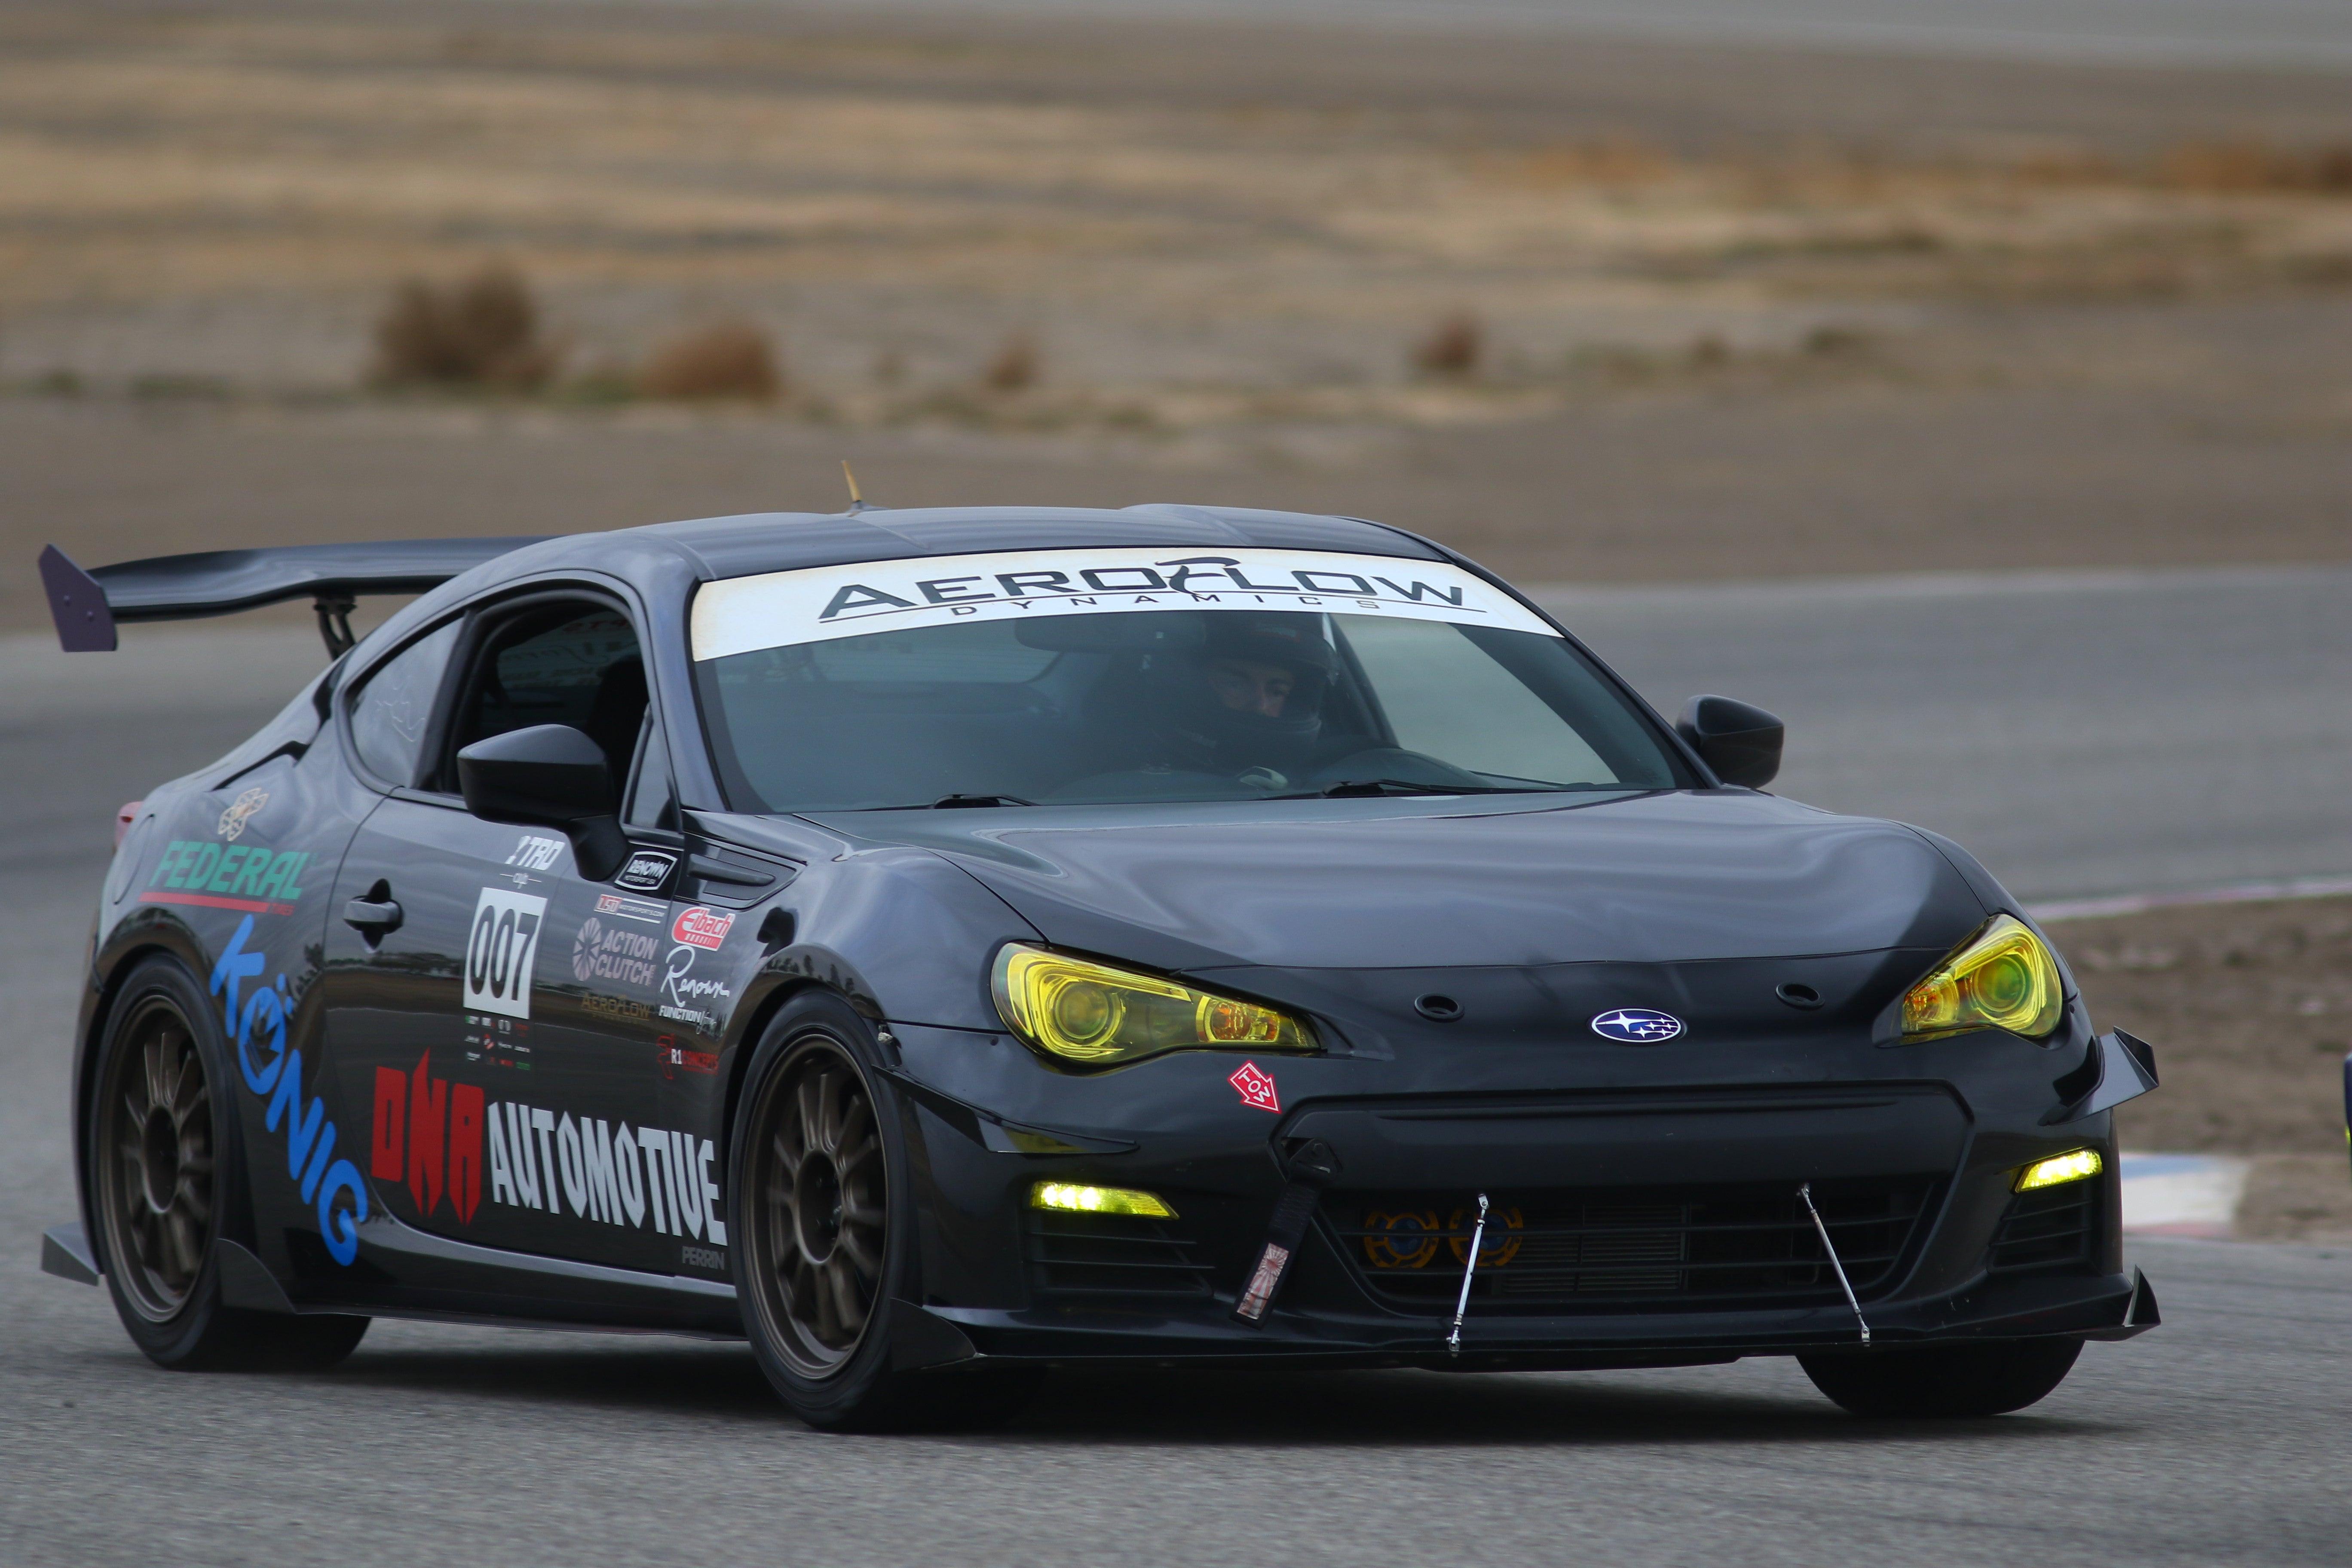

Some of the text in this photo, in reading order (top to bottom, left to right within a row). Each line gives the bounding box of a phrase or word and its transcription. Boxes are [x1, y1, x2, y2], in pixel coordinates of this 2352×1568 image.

[818, 557, 1463, 619] AEROFLOW
[952, 593, 1381, 616] DYNAMICS
[148, 840, 309, 900] FEDERAL
[626, 859, 669, 879] RENOWN
[674, 908, 732, 940] Eibach
[470, 904, 540, 1001] 007
[601, 929, 659, 960] ACTION
[595, 954, 652, 986] CLUTCH
[660, 945, 730, 1007] Renown
[1237, 1070, 1271, 1103] TOW
[370, 1047, 728, 1246] DNA AUTOMOTIVE
[682, 1246, 726, 1271] PERRIN
